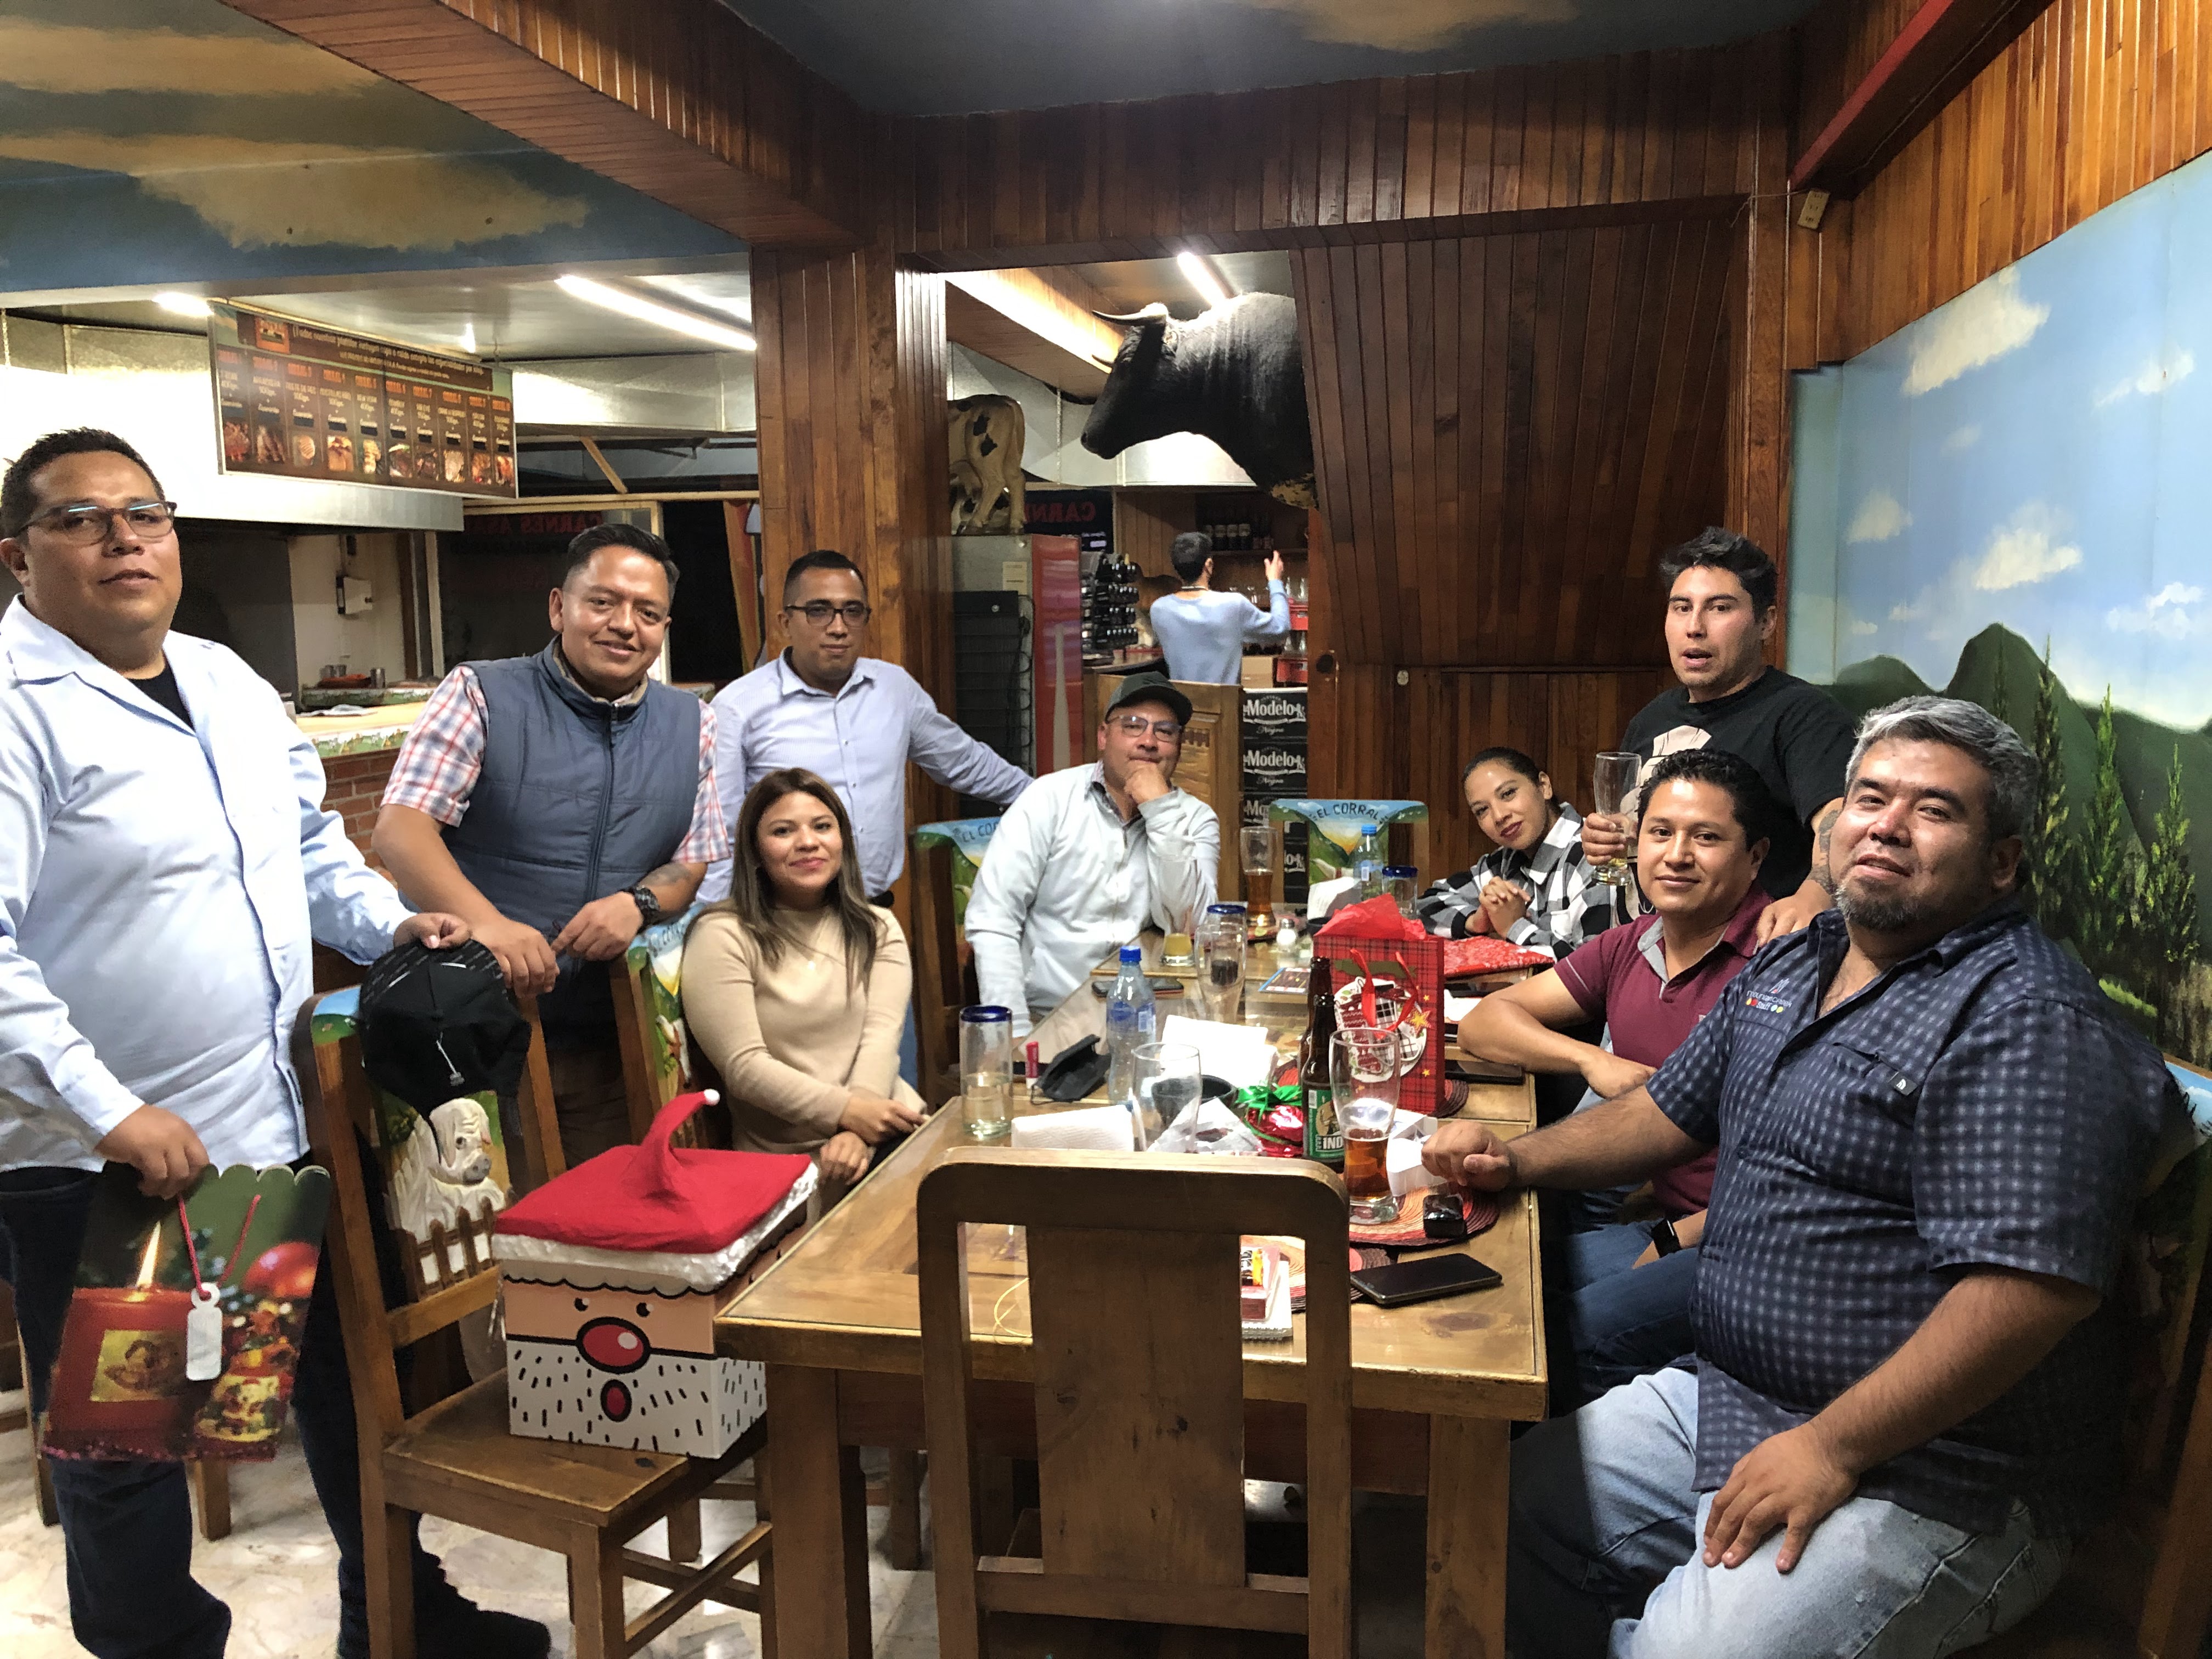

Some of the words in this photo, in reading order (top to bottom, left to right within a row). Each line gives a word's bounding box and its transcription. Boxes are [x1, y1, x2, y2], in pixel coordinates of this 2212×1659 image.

[1247, 699, 1294, 716] Modelo
[1248, 749, 1294, 766] Modelo
[1317, 809, 1330, 819] EL
[1333, 802, 1379, 820] CORRAL
